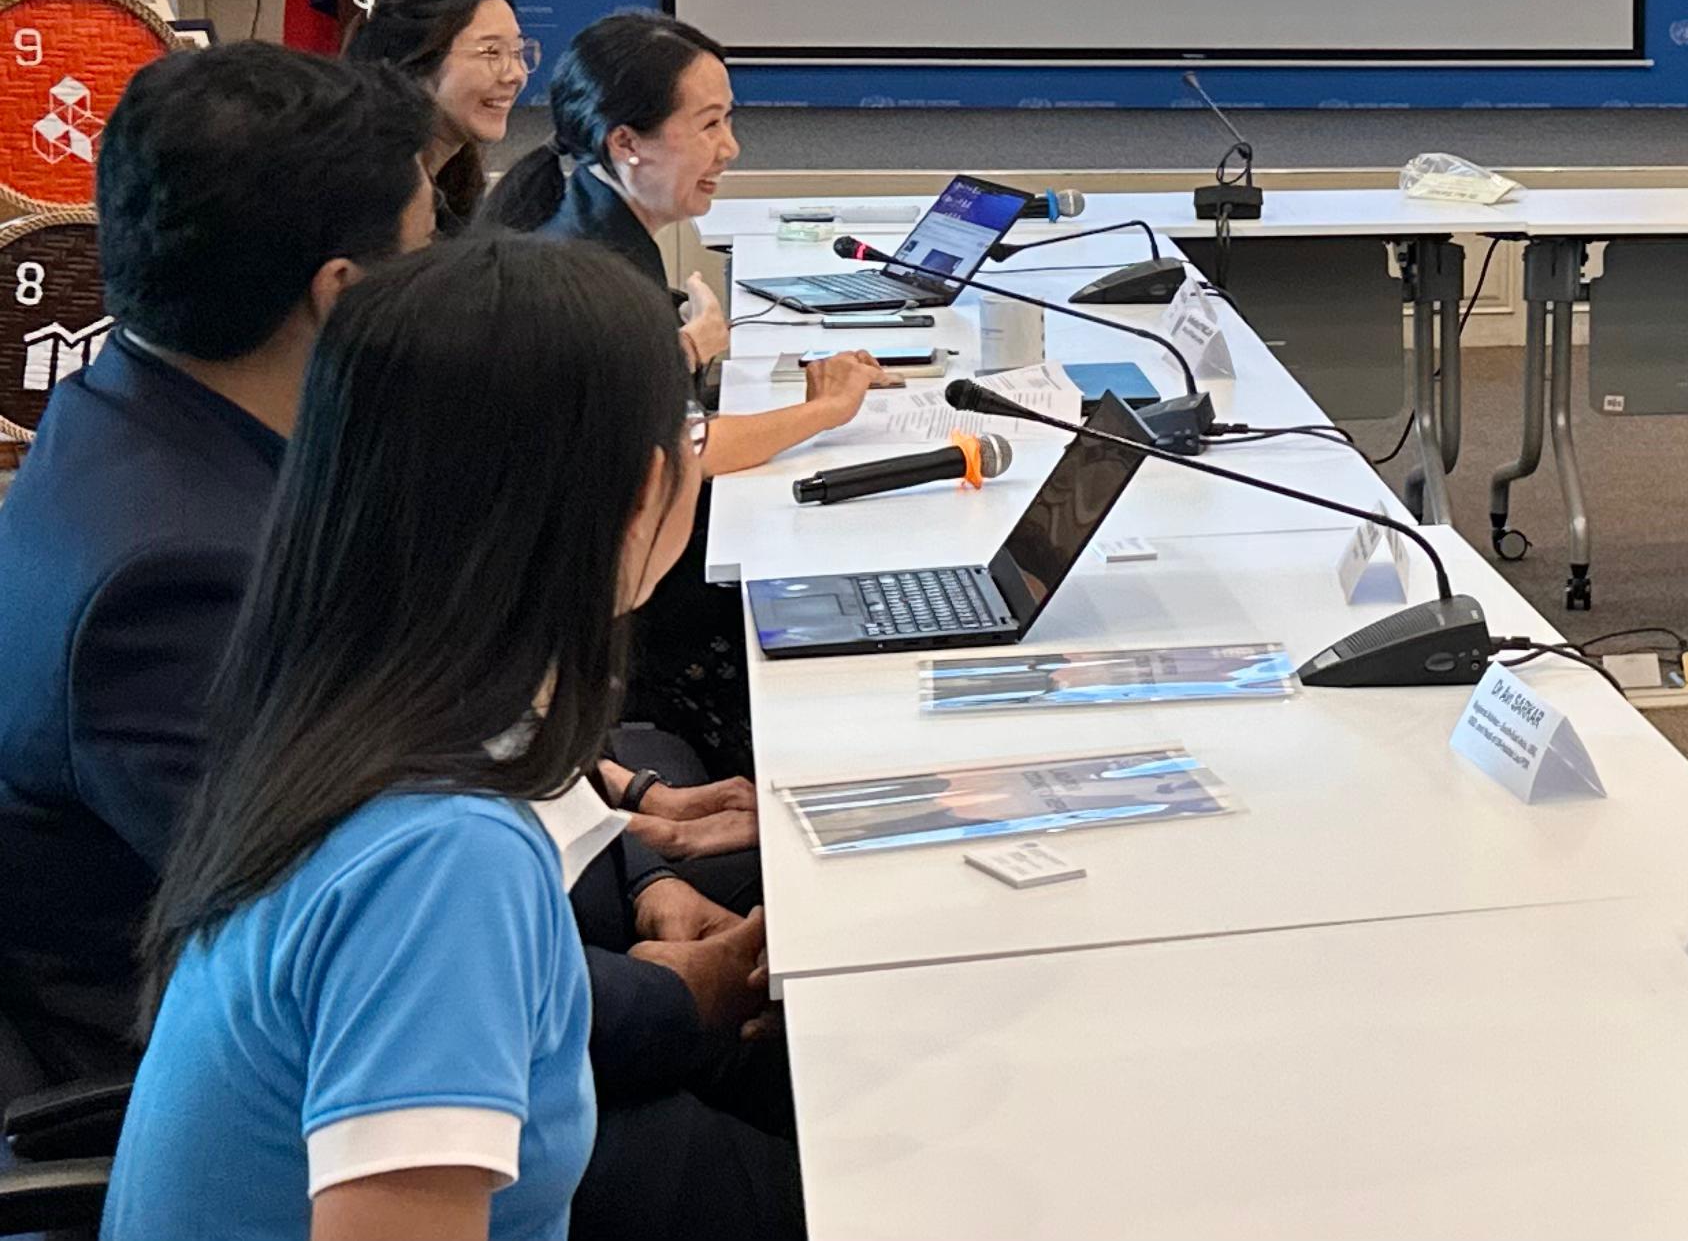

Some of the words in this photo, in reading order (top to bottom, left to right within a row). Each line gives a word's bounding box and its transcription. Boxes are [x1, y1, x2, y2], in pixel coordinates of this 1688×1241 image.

[14, 28, 43, 67] 9
[15, 262, 44, 307] 8
[1511, 693, 1546, 729] SARKAR
